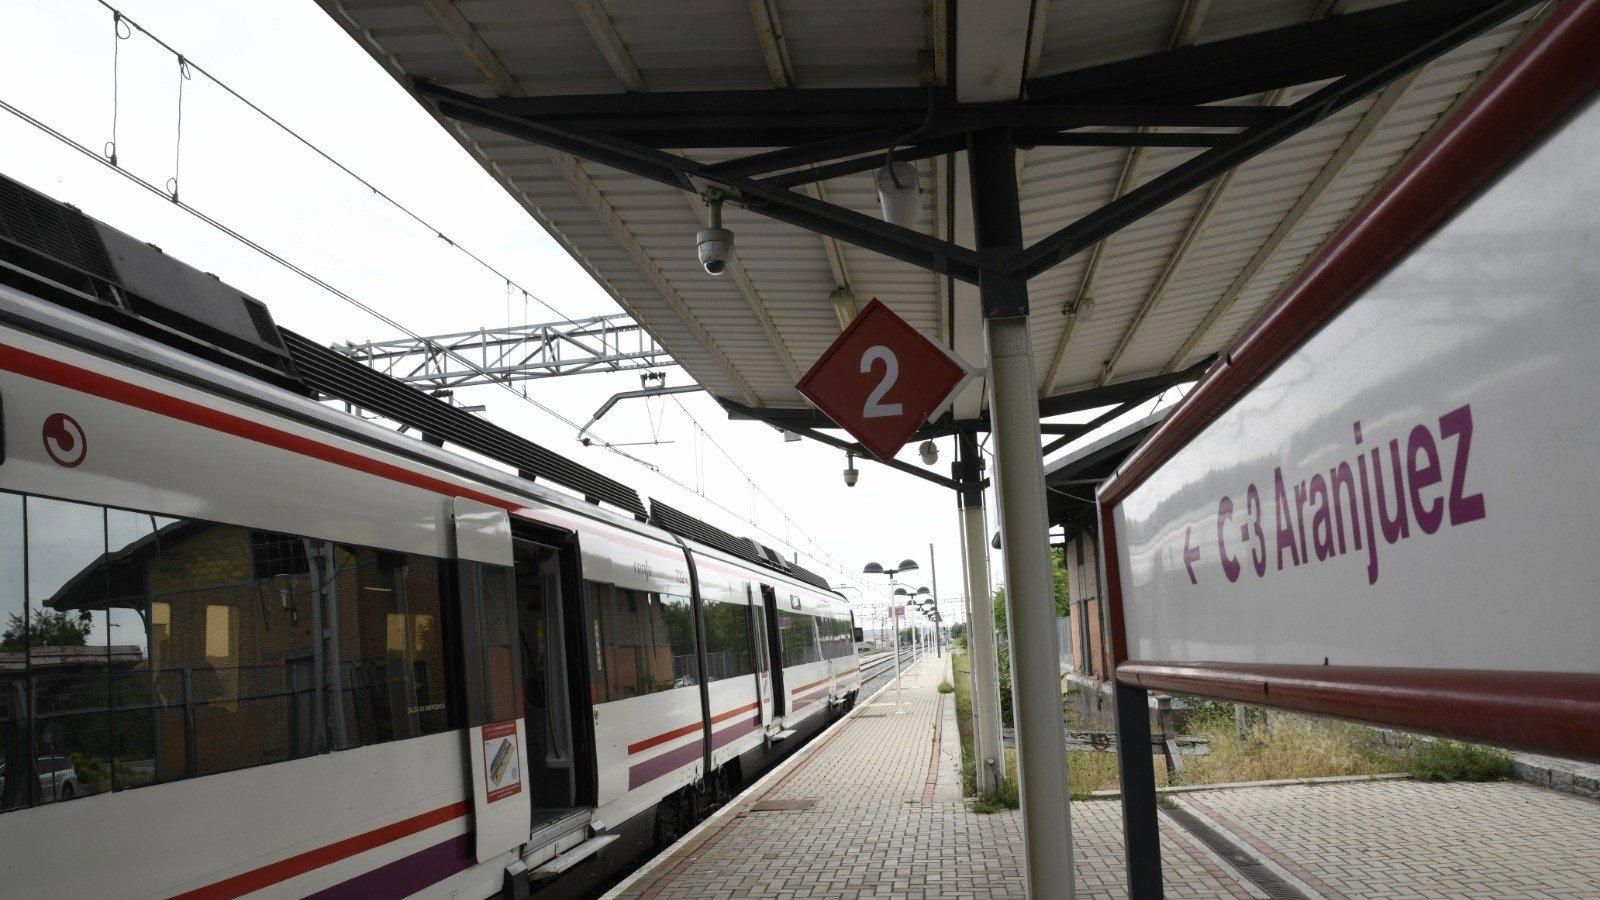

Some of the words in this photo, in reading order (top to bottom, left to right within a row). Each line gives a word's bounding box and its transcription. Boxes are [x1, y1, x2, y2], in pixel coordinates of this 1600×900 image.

[860, 345, 903, 419] 2
[1218, 496, 1267, 583] C-3
[1274, 403, 1486, 585] Aranjuez
